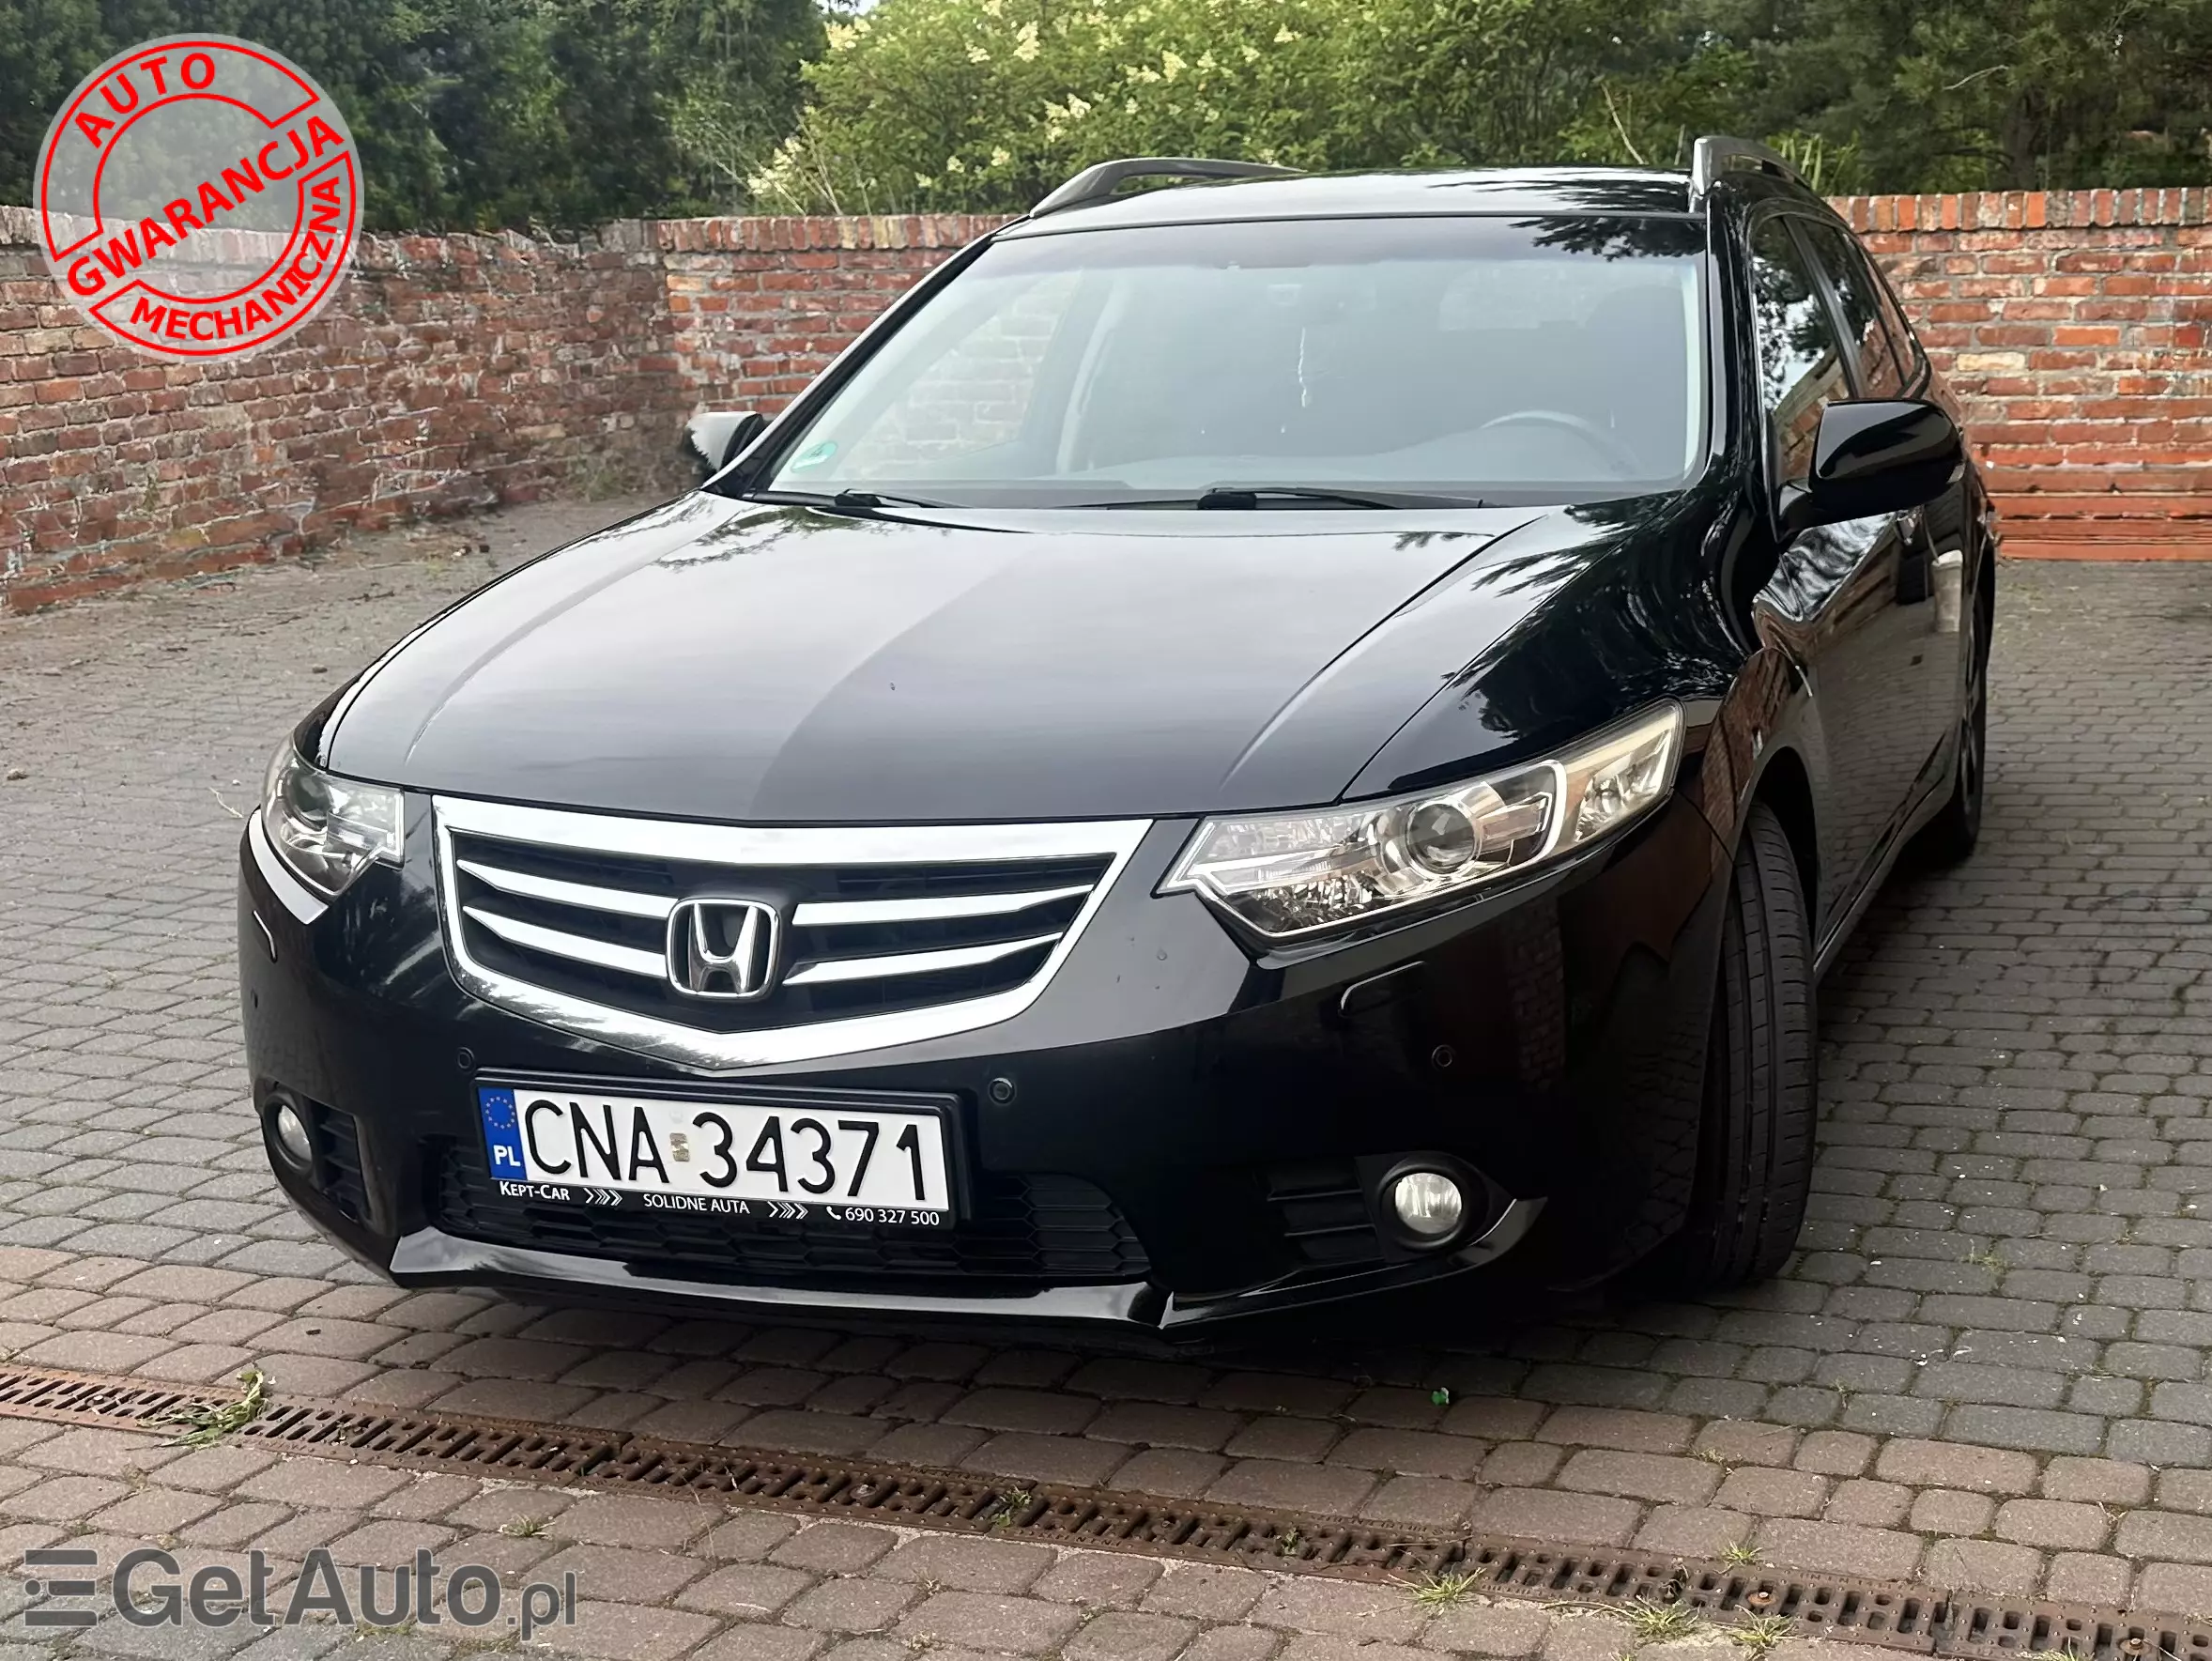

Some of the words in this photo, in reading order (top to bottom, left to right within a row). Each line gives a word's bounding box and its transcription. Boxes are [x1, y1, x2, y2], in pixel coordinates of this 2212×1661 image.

[494, 1145, 521, 1166] PL
[525, 1100, 669, 1183] CNA
[693, 1112, 926, 1201] 34371
[499, 1181, 571, 1201] KEPT-CAR
[643, 1193, 708, 1211] SOLIDNE
[711, 1199, 750, 1214] AUTA
[845, 1207, 874, 1222] 690
[878, 1209, 907, 1224] 327
[911, 1210, 940, 1225] 500
